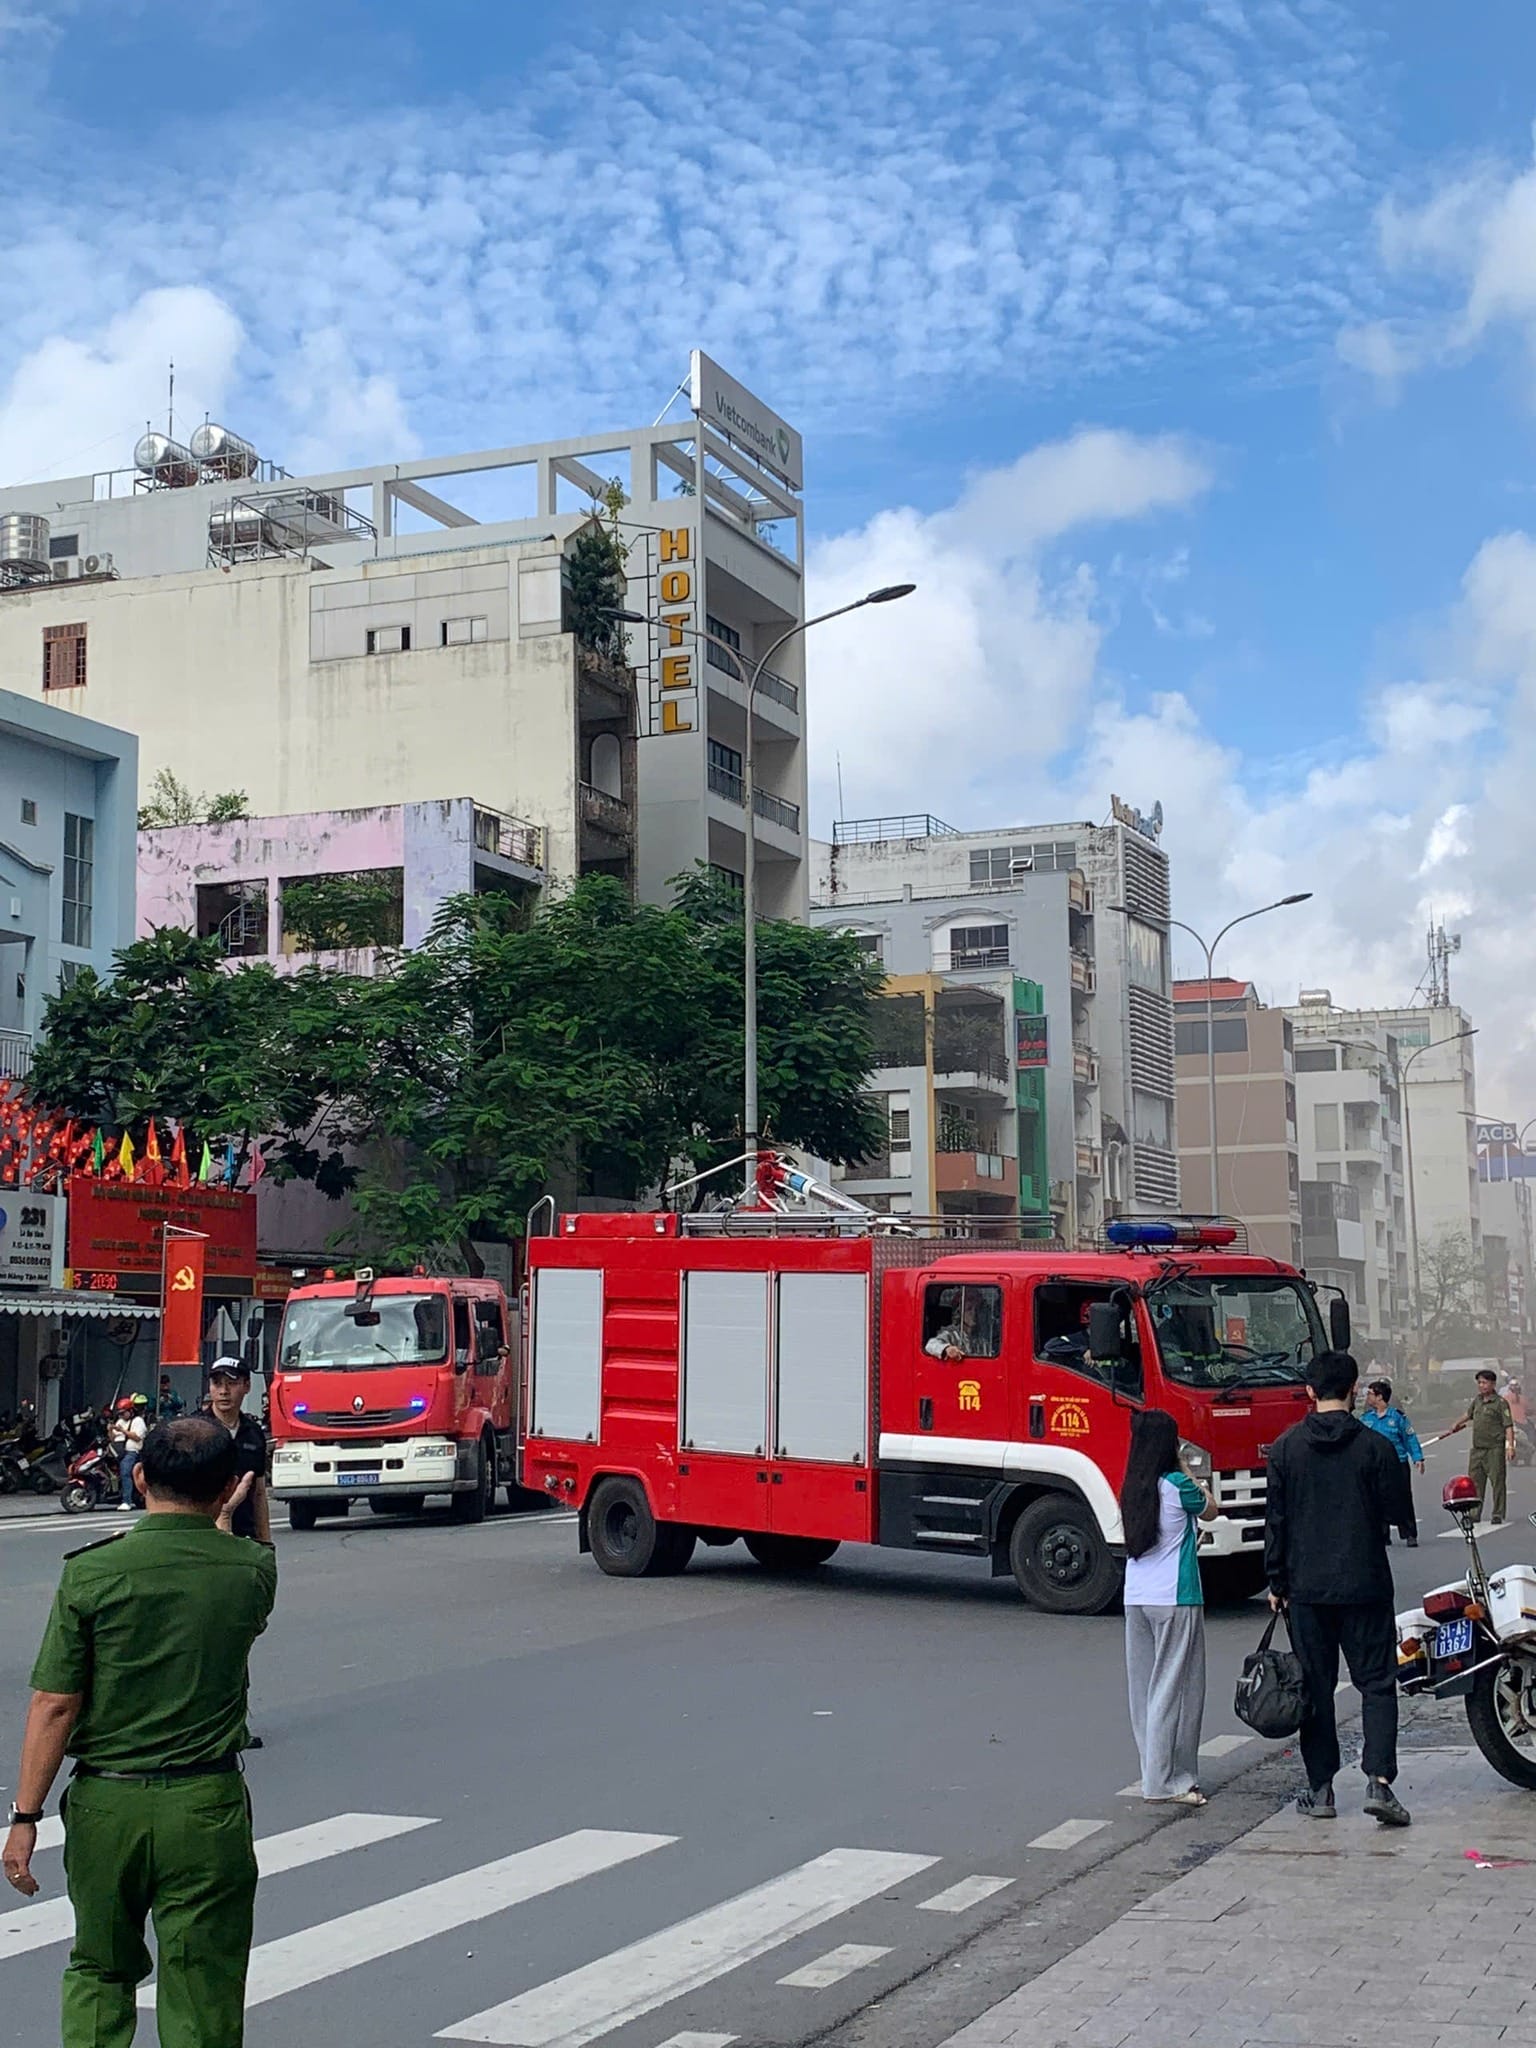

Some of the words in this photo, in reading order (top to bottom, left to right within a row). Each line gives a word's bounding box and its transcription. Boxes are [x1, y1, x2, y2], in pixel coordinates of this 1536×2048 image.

[715, 391, 777, 457] Vietcombank
[660, 527, 692, 733] HOTEL
[1478, 1126, 1515, 1141] ACB
[20, 1207, 46, 1226] 231
[958, 1396, 981, 1411] 114
[1061, 1412, 1079, 1428] 114
[1440, 1635, 1467, 1655] 0362
